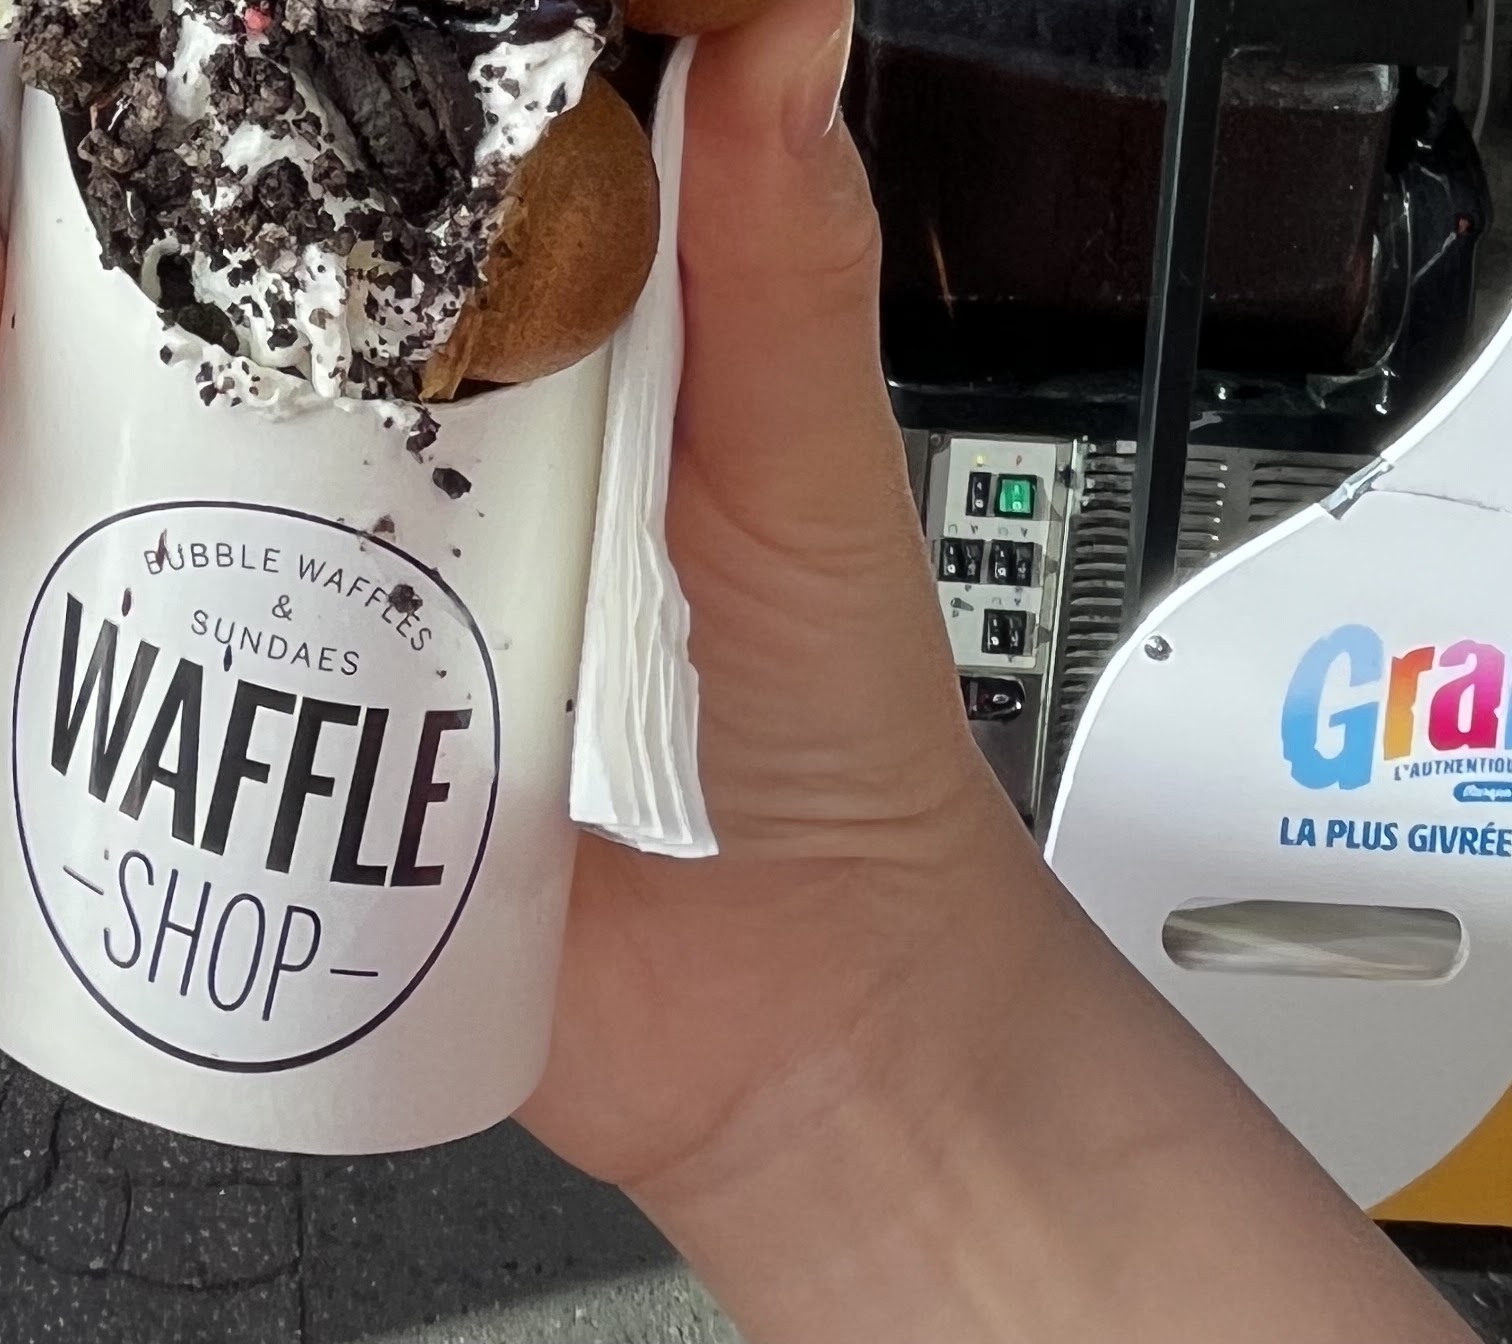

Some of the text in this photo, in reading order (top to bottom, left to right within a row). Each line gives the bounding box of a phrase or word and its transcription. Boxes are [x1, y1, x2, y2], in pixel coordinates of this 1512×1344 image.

[144, 542, 432, 652] BUBBLE WAFFLES
[191, 610, 359, 676] SUNDAES
[272, 595, 293, 622] &
[51, 592, 473, 888] WAFFLE
[1280, 623, 1512, 790] Gra
[1280, 817, 1512, 858] LA PLUS GIVRÉE
[104, 850, 322, 1022] SHOP
